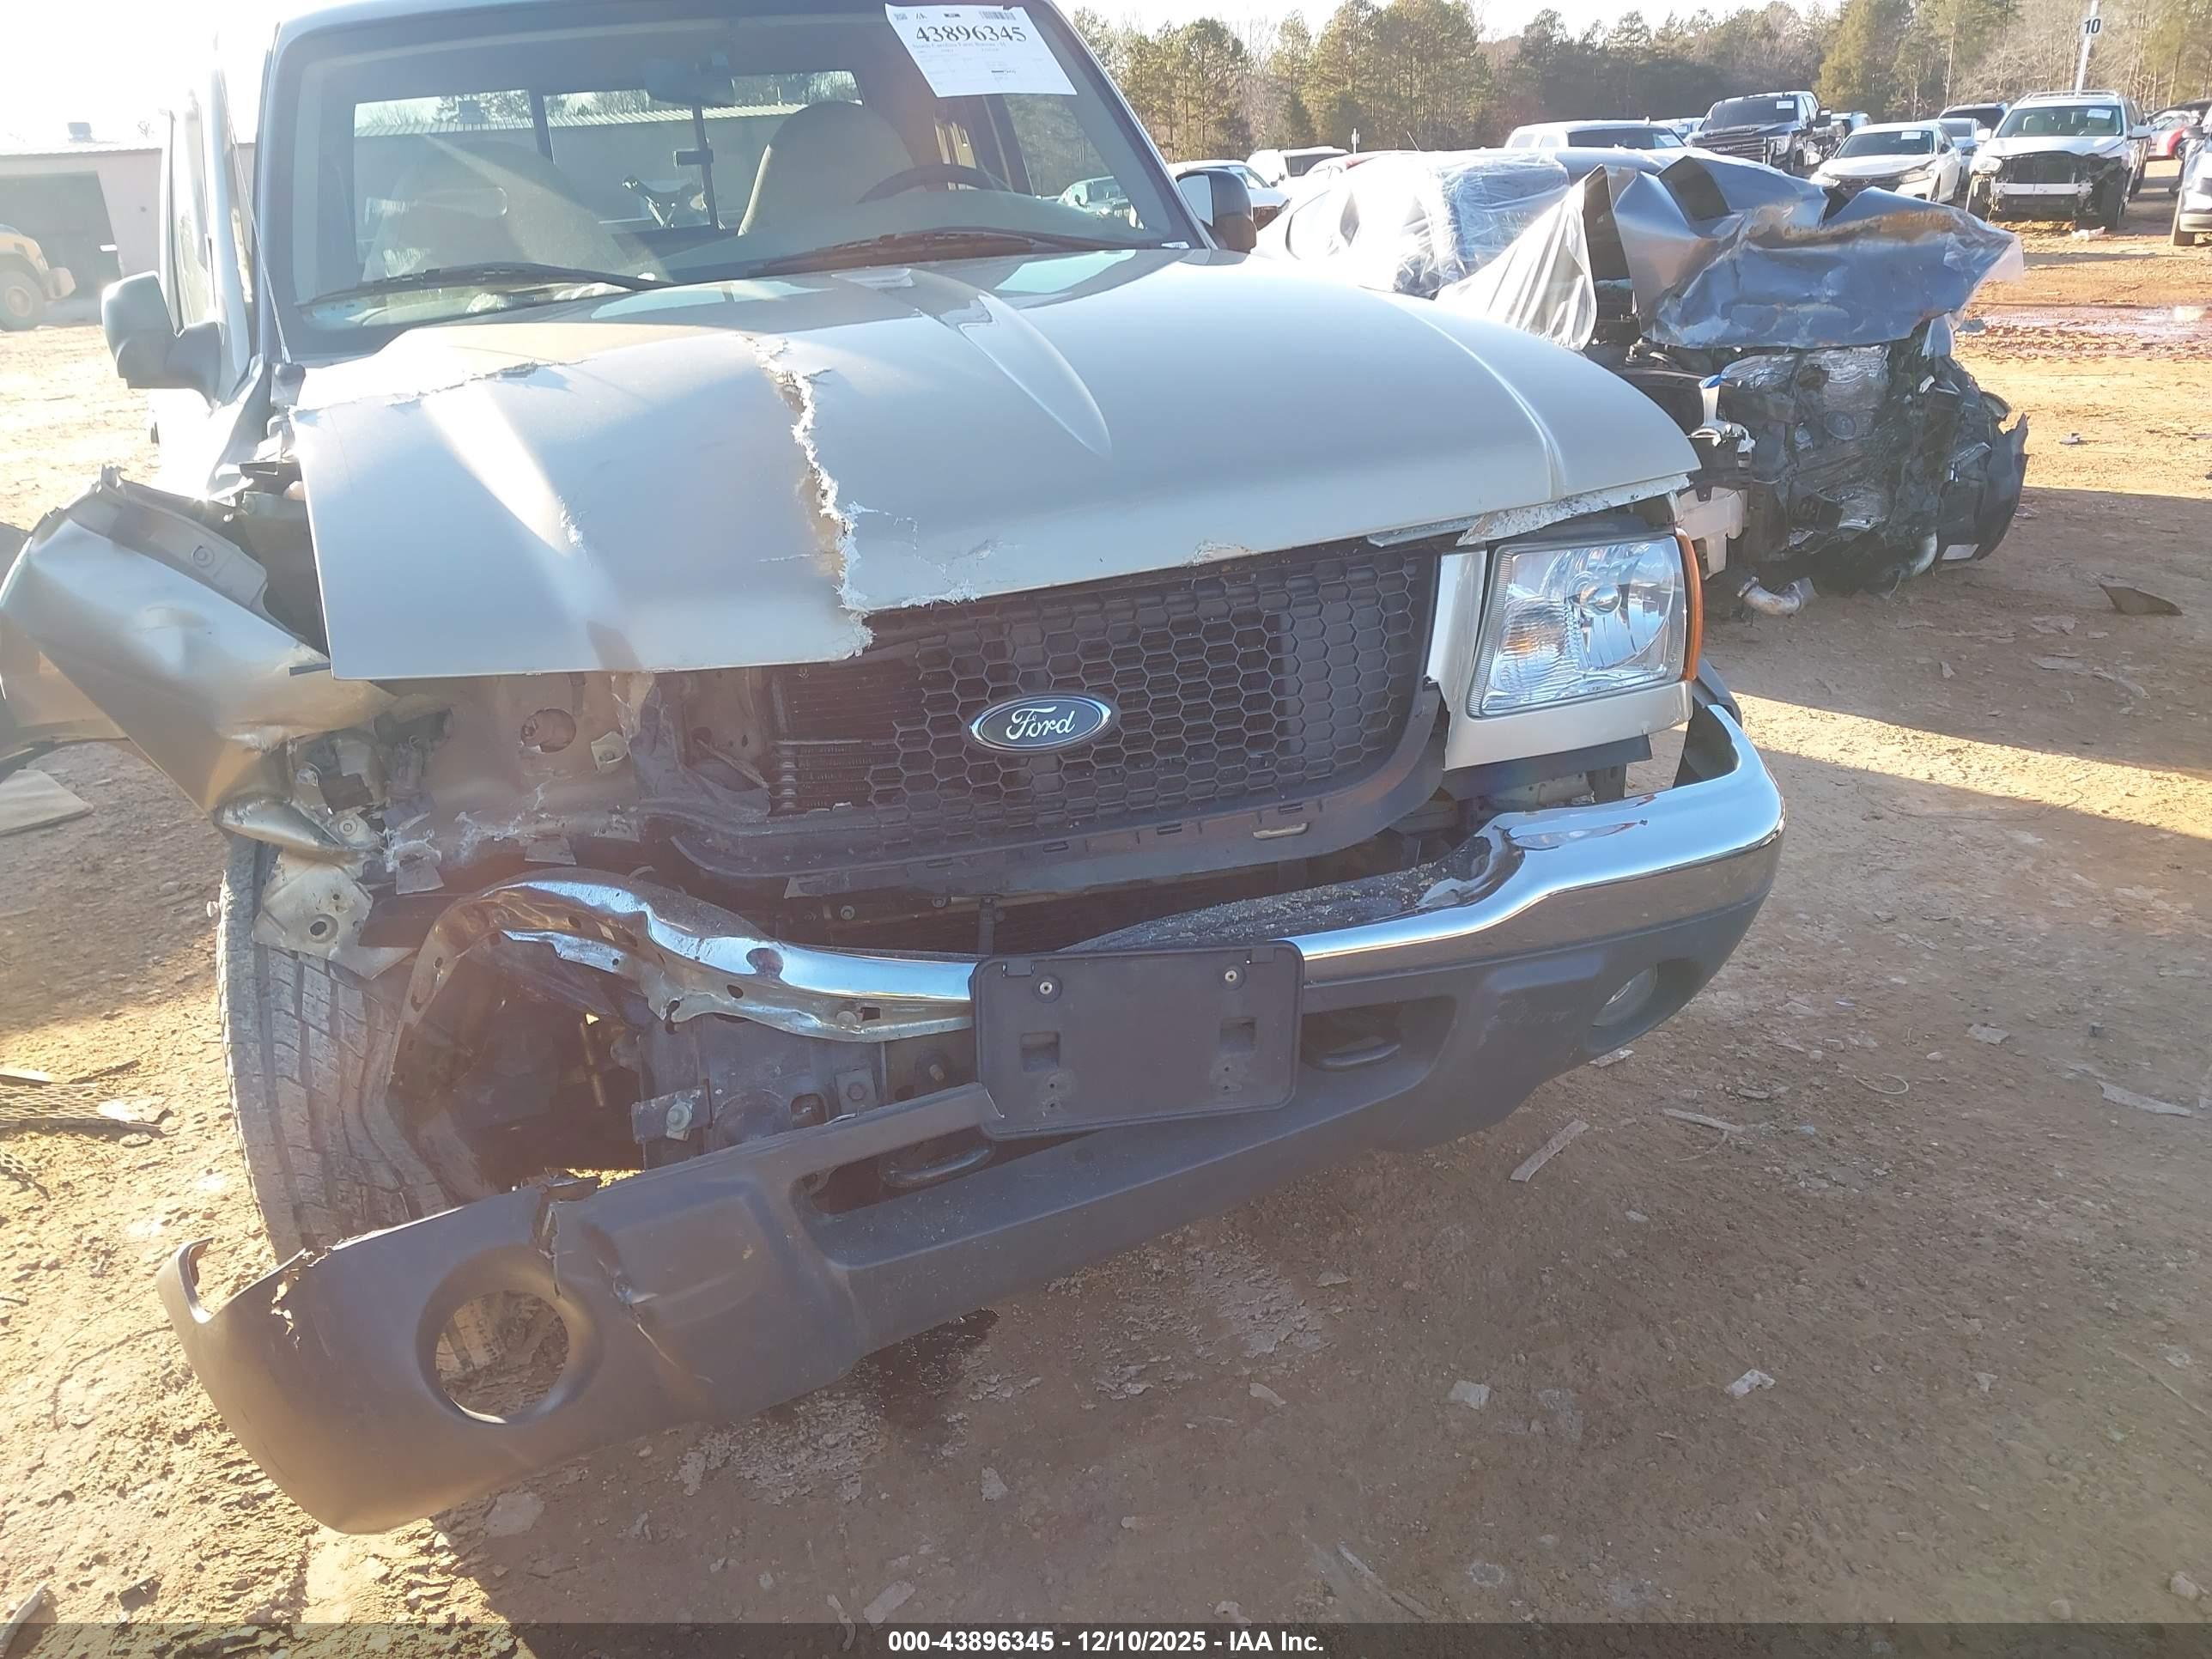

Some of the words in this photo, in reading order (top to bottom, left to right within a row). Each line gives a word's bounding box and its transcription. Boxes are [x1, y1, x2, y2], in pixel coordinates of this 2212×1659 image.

[916, 26, 1027, 42] 43896345
[2084, 18, 2101, 34] 10
[1006, 706, 1076, 740] Ford
